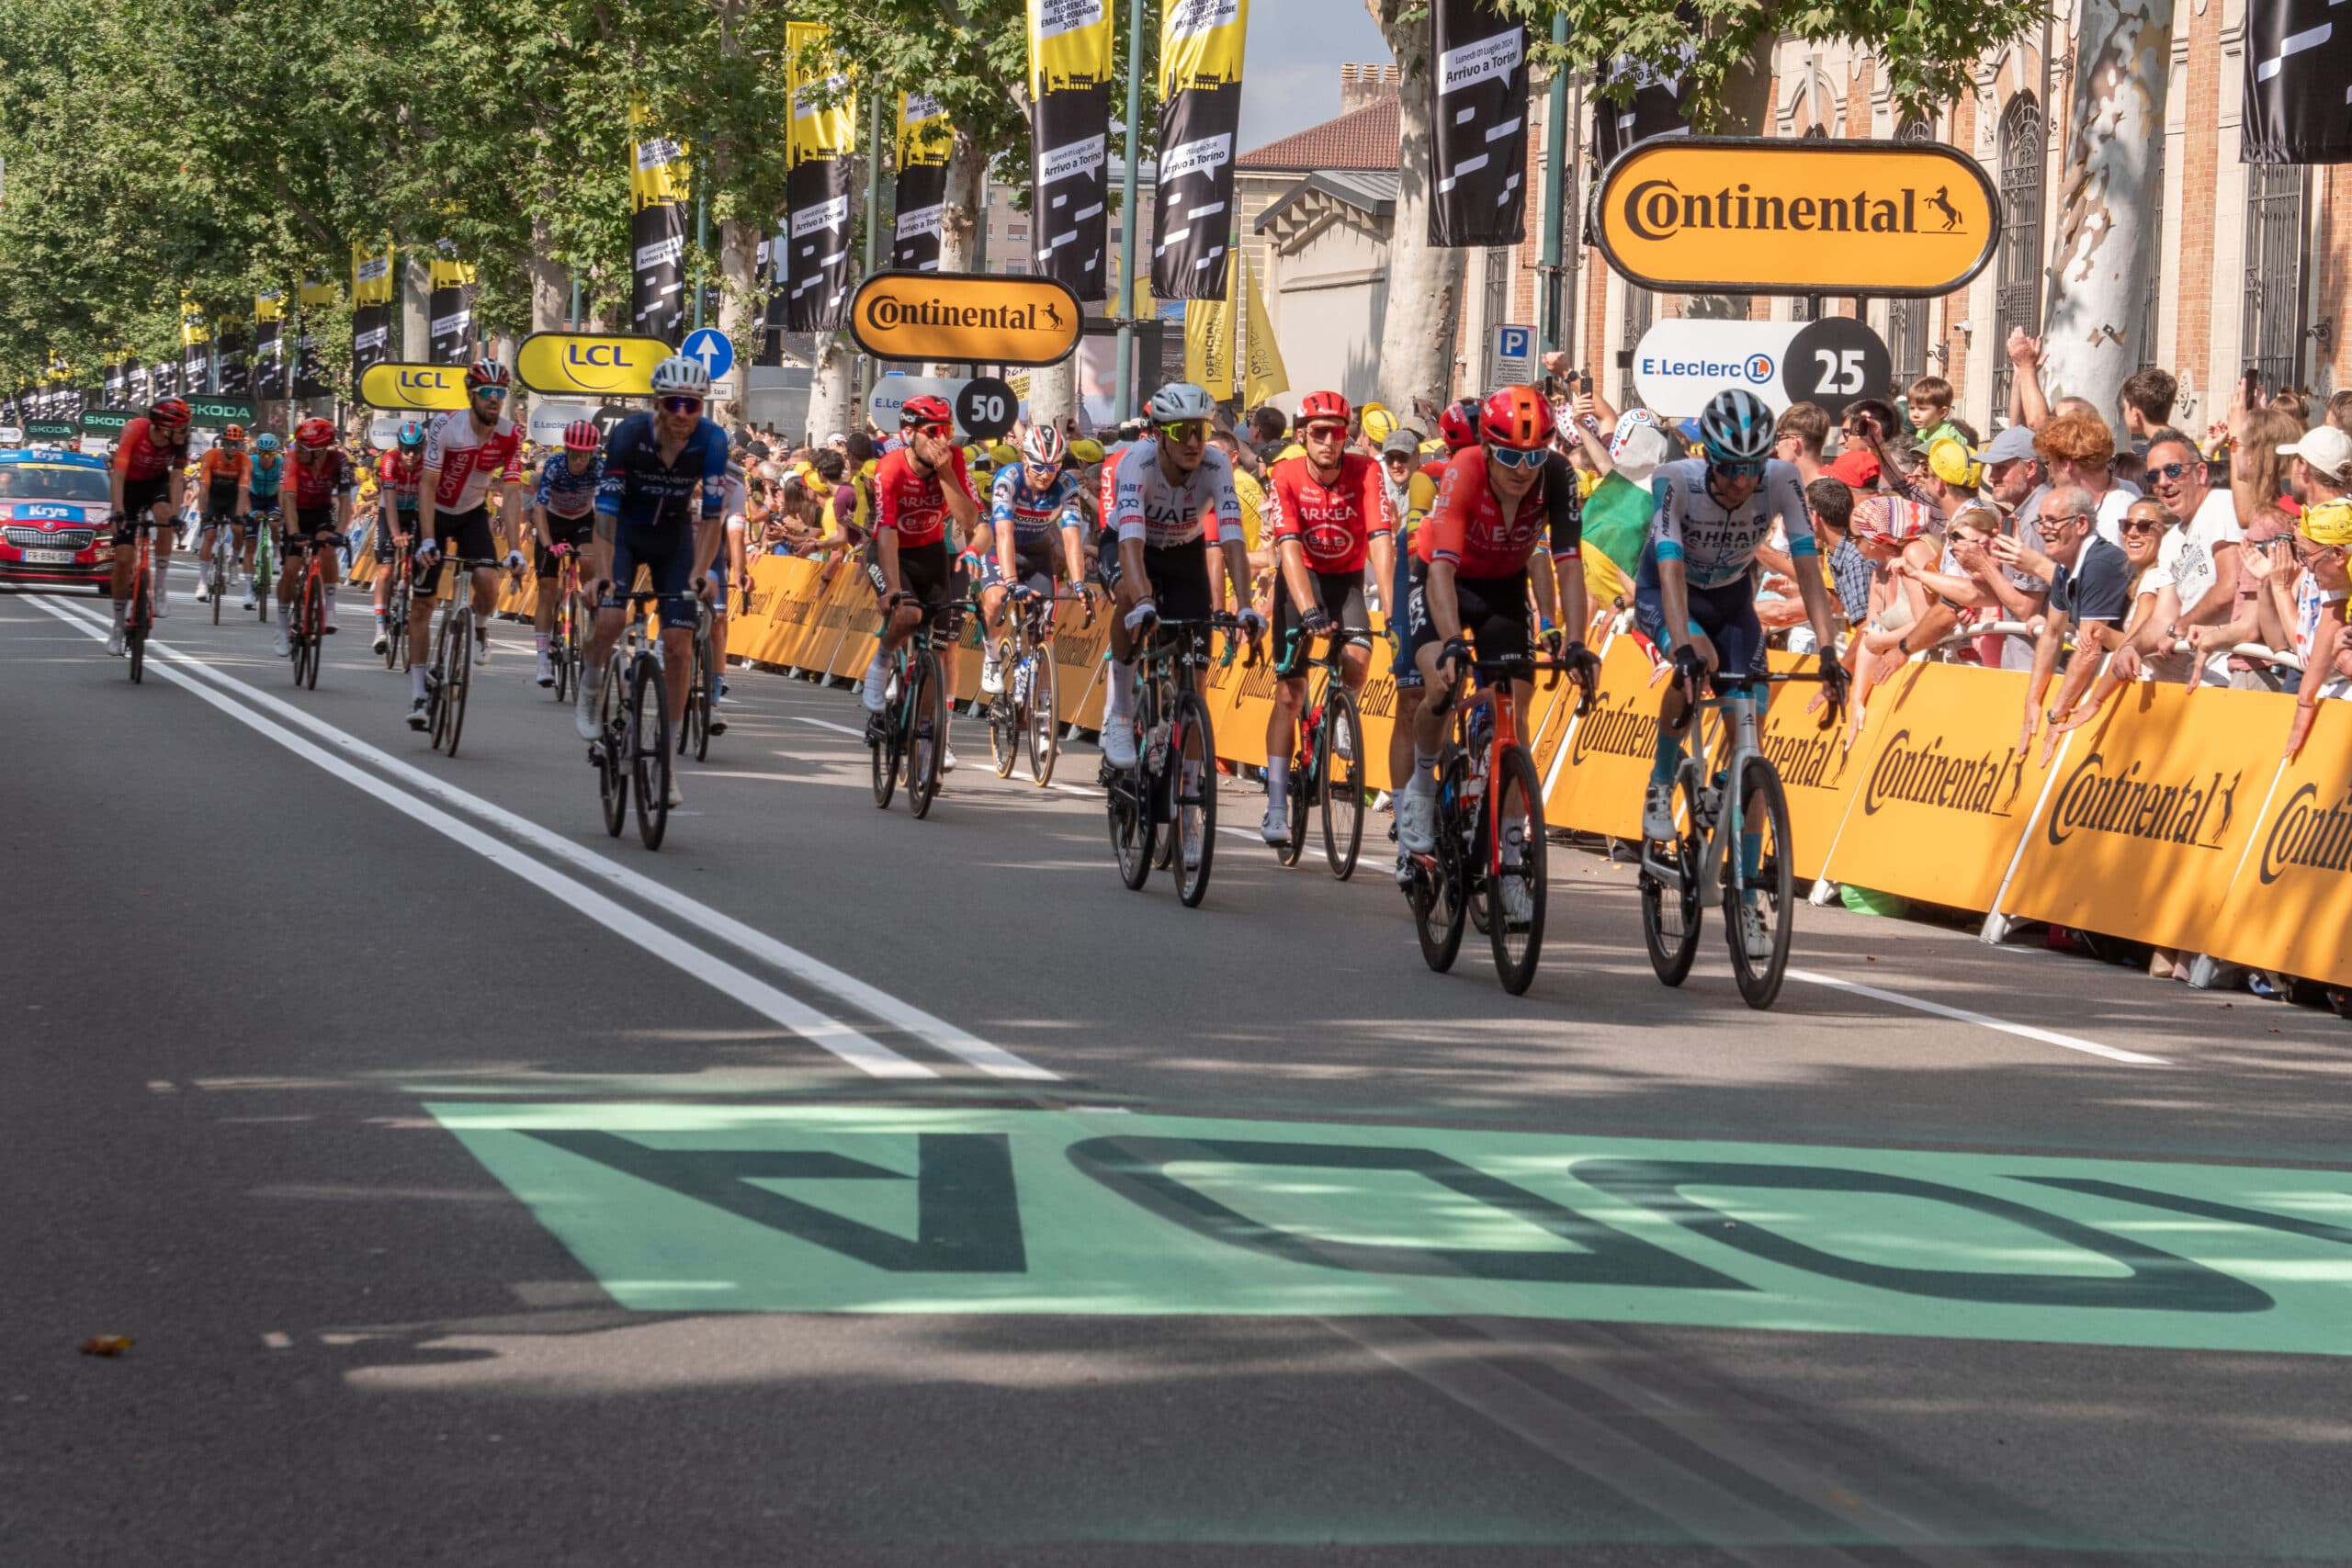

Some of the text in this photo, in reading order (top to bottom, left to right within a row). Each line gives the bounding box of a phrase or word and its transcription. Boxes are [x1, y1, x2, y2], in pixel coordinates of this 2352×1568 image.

[1054, 0, 1088, 15] FLORENCE
[1063, 18, 1079, 29] 2024
[1484, 42, 1501, 55] Luglio
[1445, 51, 1518, 84] Arrivo a Torin
[1045, 163, 1070, 177] Arrivo
[1079, 152, 1102, 165] Torino
[1197, 151, 1225, 164] Torino
[1624, 178, 1917, 242] Continental
[866, 295, 1036, 331] Continental
[1506, 332, 1523, 354] P
[569, 344, 633, 367] LCL
[1642, 357, 1742, 378] E.Leclerc
[1814, 350, 1866, 395] 25
[401, 371, 450, 389] LCL
[875, 397, 903, 409] E.Lec
[970, 395, 1005, 423] 50
[28, 425, 72, 434] SKODA
[85, 415, 127, 427] SKOD
[534, 421, 567, 429] E.Lecle
[429, 417, 448, 461] Cofidis
[32, 450, 63, 460] Krys
[437, 453, 470, 499] Cofidis
[897, 495, 942, 507] ARKE
[1270, 478, 1285, 528] ARKEA
[1432, 467, 1459, 525] INEOS
[28, 505, 69, 517] Krys
[1145, 504, 1198, 524] UAE
[1300, 505, 1359, 521] ARKEA
[1661, 484, 1676, 537] MERIDA
[1864, 728, 2016, 817] Continental
[2048, 752, 2223, 846] Continental
